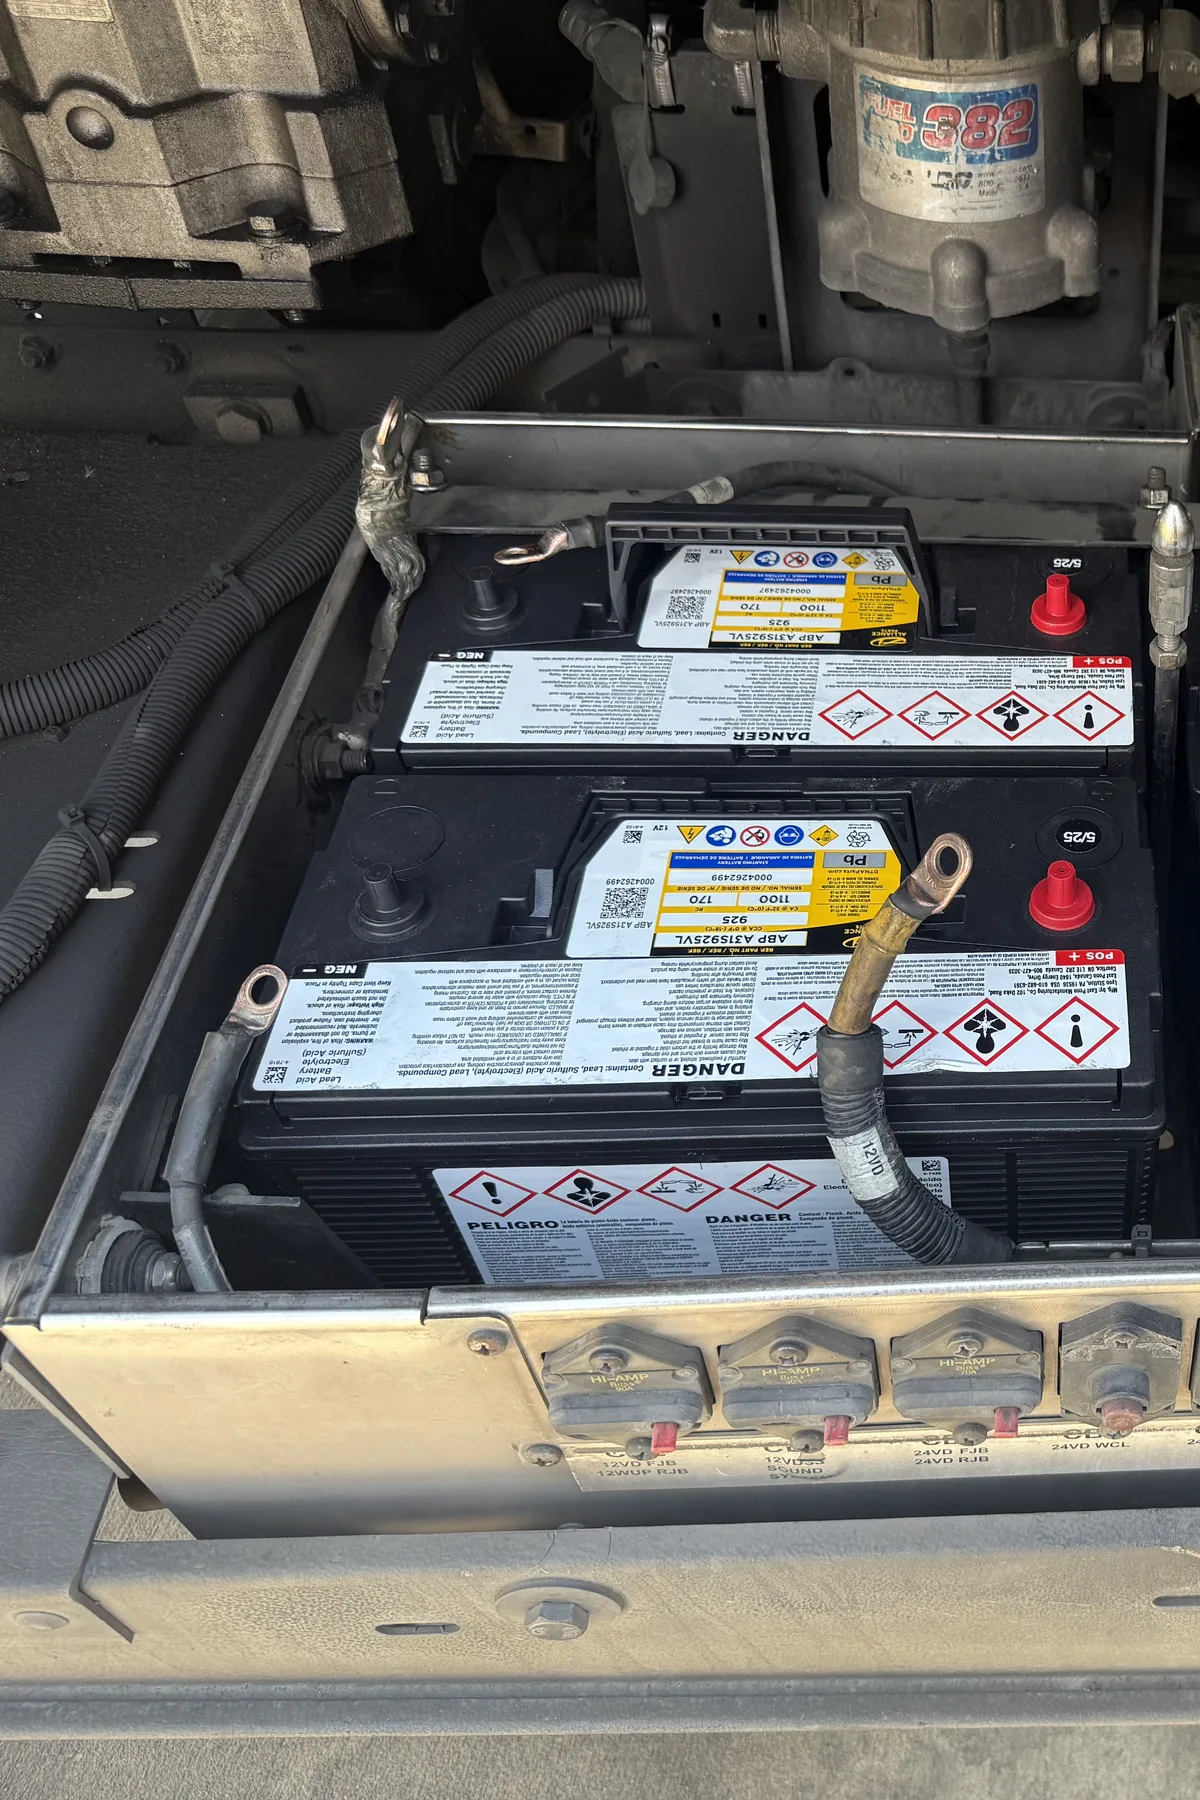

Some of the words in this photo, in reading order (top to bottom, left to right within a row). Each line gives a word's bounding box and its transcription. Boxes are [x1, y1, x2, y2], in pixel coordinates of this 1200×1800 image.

[864, 90, 916, 124] FUEL
[920, 96, 1036, 152] 382
[1053, 558, 1082, 568] 5/25
[871, 574, 892, 585] Pb
[669, 588, 712, 596] 0004262497
[759, 587, 811, 595] 0004262497
[740, 603, 761, 611] 170
[799, 604, 826, 612] 1100
[728, 632, 795, 642] A31S925VL
[799, 633, 824, 642] ABP
[456, 651, 485, 660] NEG
[1098, 657, 1123, 665] POS
[732, 731, 811, 741] DANGER
[652, 823, 669, 832] 12V
[1063, 830, 1096, 843] 5/25
[843, 853, 868, 867] Pb
[605, 877, 656, 886] 0004262499
[711, 873, 773, 882] 0004262499
[689, 895, 713, 905] 170
[759, 894, 791, 904] 1100
[722, 914, 748, 925] 925
[585, 920, 633, 930] A31S925VL
[633, 920, 653, 929] ABP
[674, 934, 754, 946] A31S925VL
[757, 933, 789, 945] ABP
[1085, 951, 1114, 960] POS
[324, 965, 358, 974] NEG
[302, 1049, 327, 1057] Acid)
[328, 1048, 367, 1057] (Sulfuric
[299, 1067, 332, 1075] Battery
[396, 1068, 448, 1077] Compounds.
[449, 1068, 470, 1076] Lead
[471, 1066, 525, 1076] (Electrolyte),
[546, 1066, 580, 1074] Sulfuric
[580, 1064, 604, 1073] Lead,
[604, 1064, 644, 1072] Contains:
[651, 1062, 746, 1077] DANGER
[319, 1076, 342, 1084] Lead
[862, 1141, 885, 1176] 12VD
[705, 1213, 792, 1224] DANGER
[467, 1220, 559, 1230] PELIGRO
[939, 1357, 996, 1367] HI-AMP
[590, 1373, 649, 1384] HI-AMP
[1051, 1442, 1091, 1451] 24VD
[1096, 1441, 1131, 1449] WCL
[602, 1460, 641, 1468] 12VD
[915, 1457, 954, 1465] 24VD
[958, 1455, 990, 1463] RJB
[596, 1469, 652, 1477] 12WUP
[767, 1465, 823, 1474] SOUND
